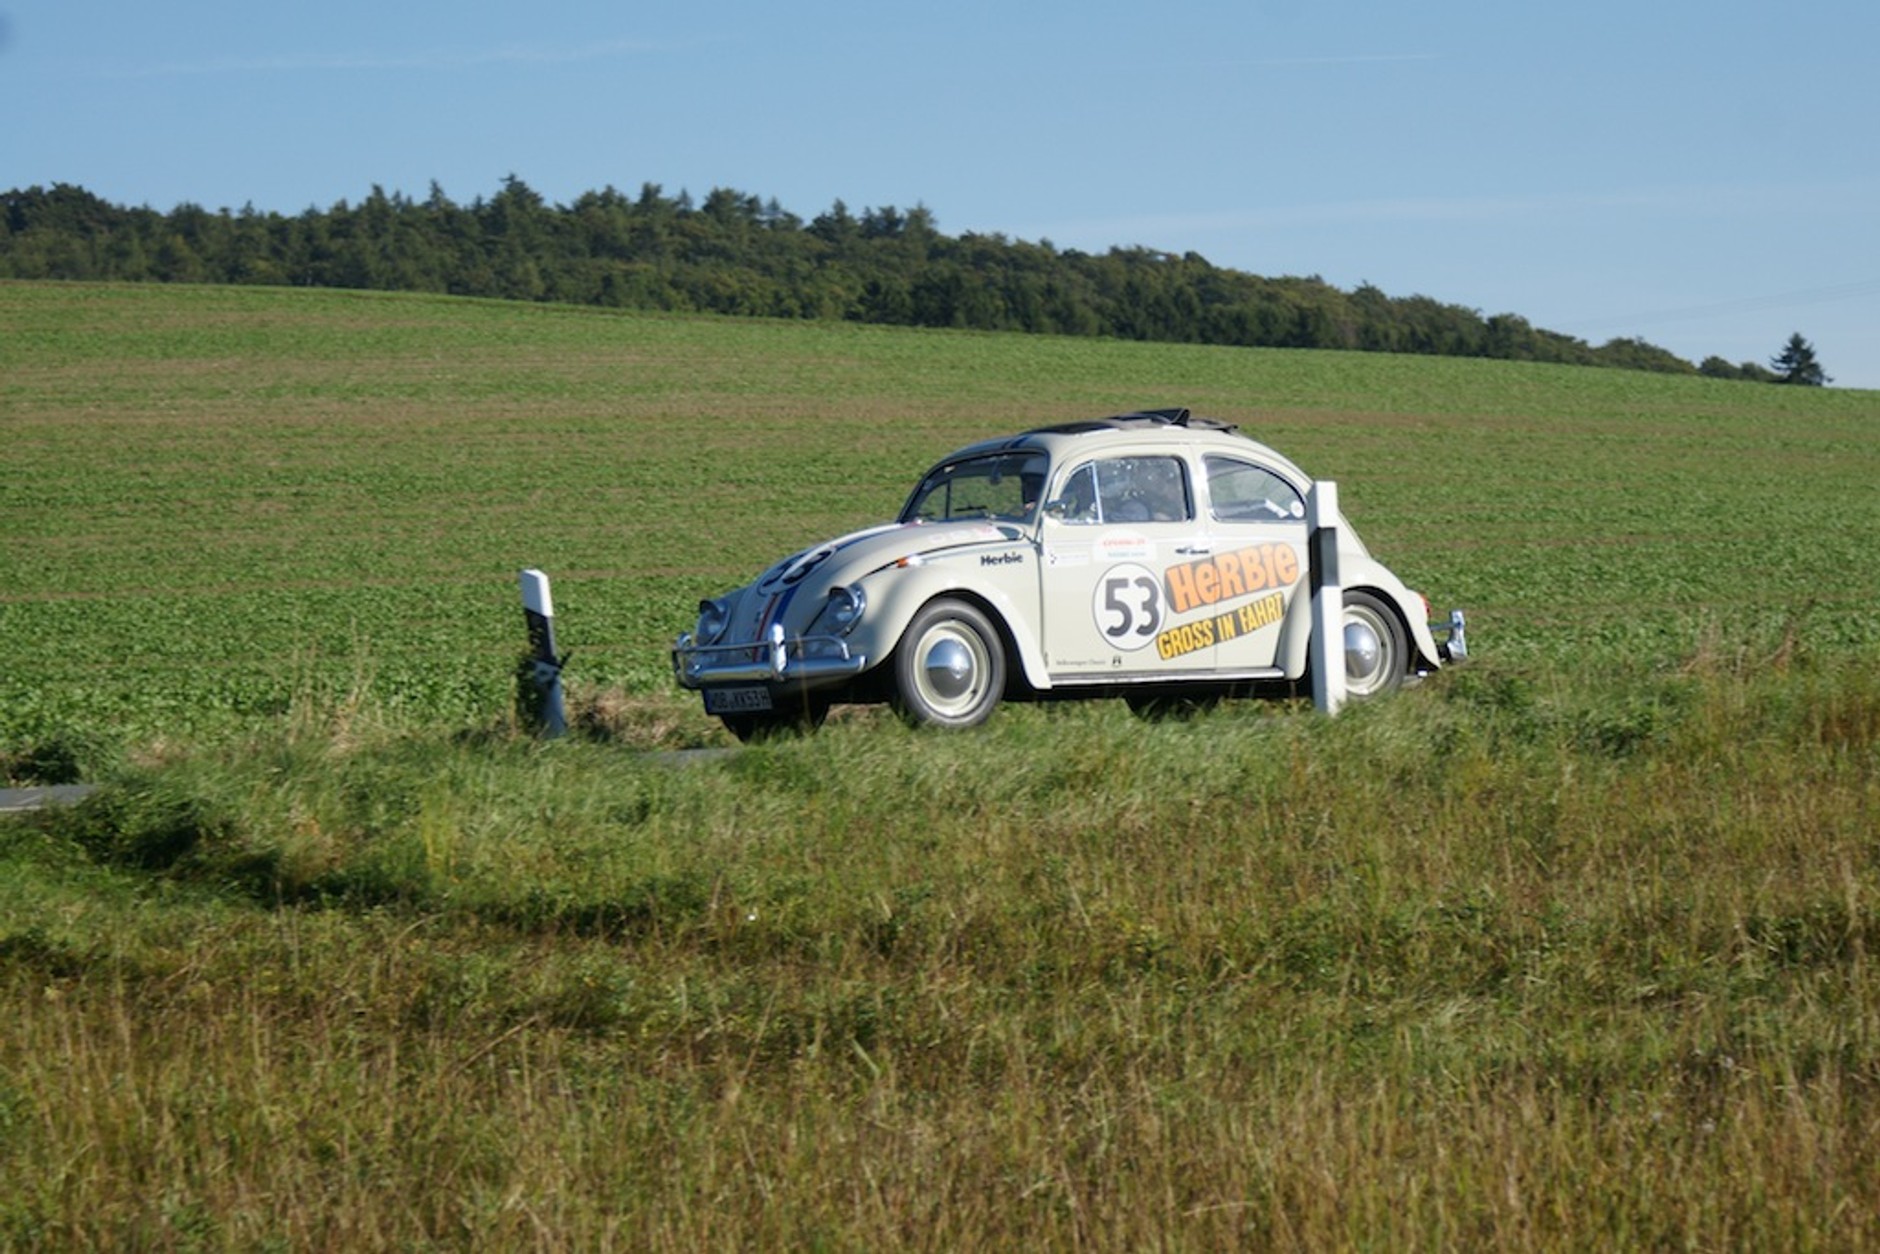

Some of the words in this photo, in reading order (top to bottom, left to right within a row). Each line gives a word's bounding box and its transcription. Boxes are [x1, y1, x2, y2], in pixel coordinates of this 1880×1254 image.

[980, 551, 1024, 567] Herbie
[1104, 576, 1161, 638] 53
[1157, 620, 1214, 661] GROSS
[1218, 615, 1236, 641] IN
[1240, 592, 1285, 634] FAHRT
